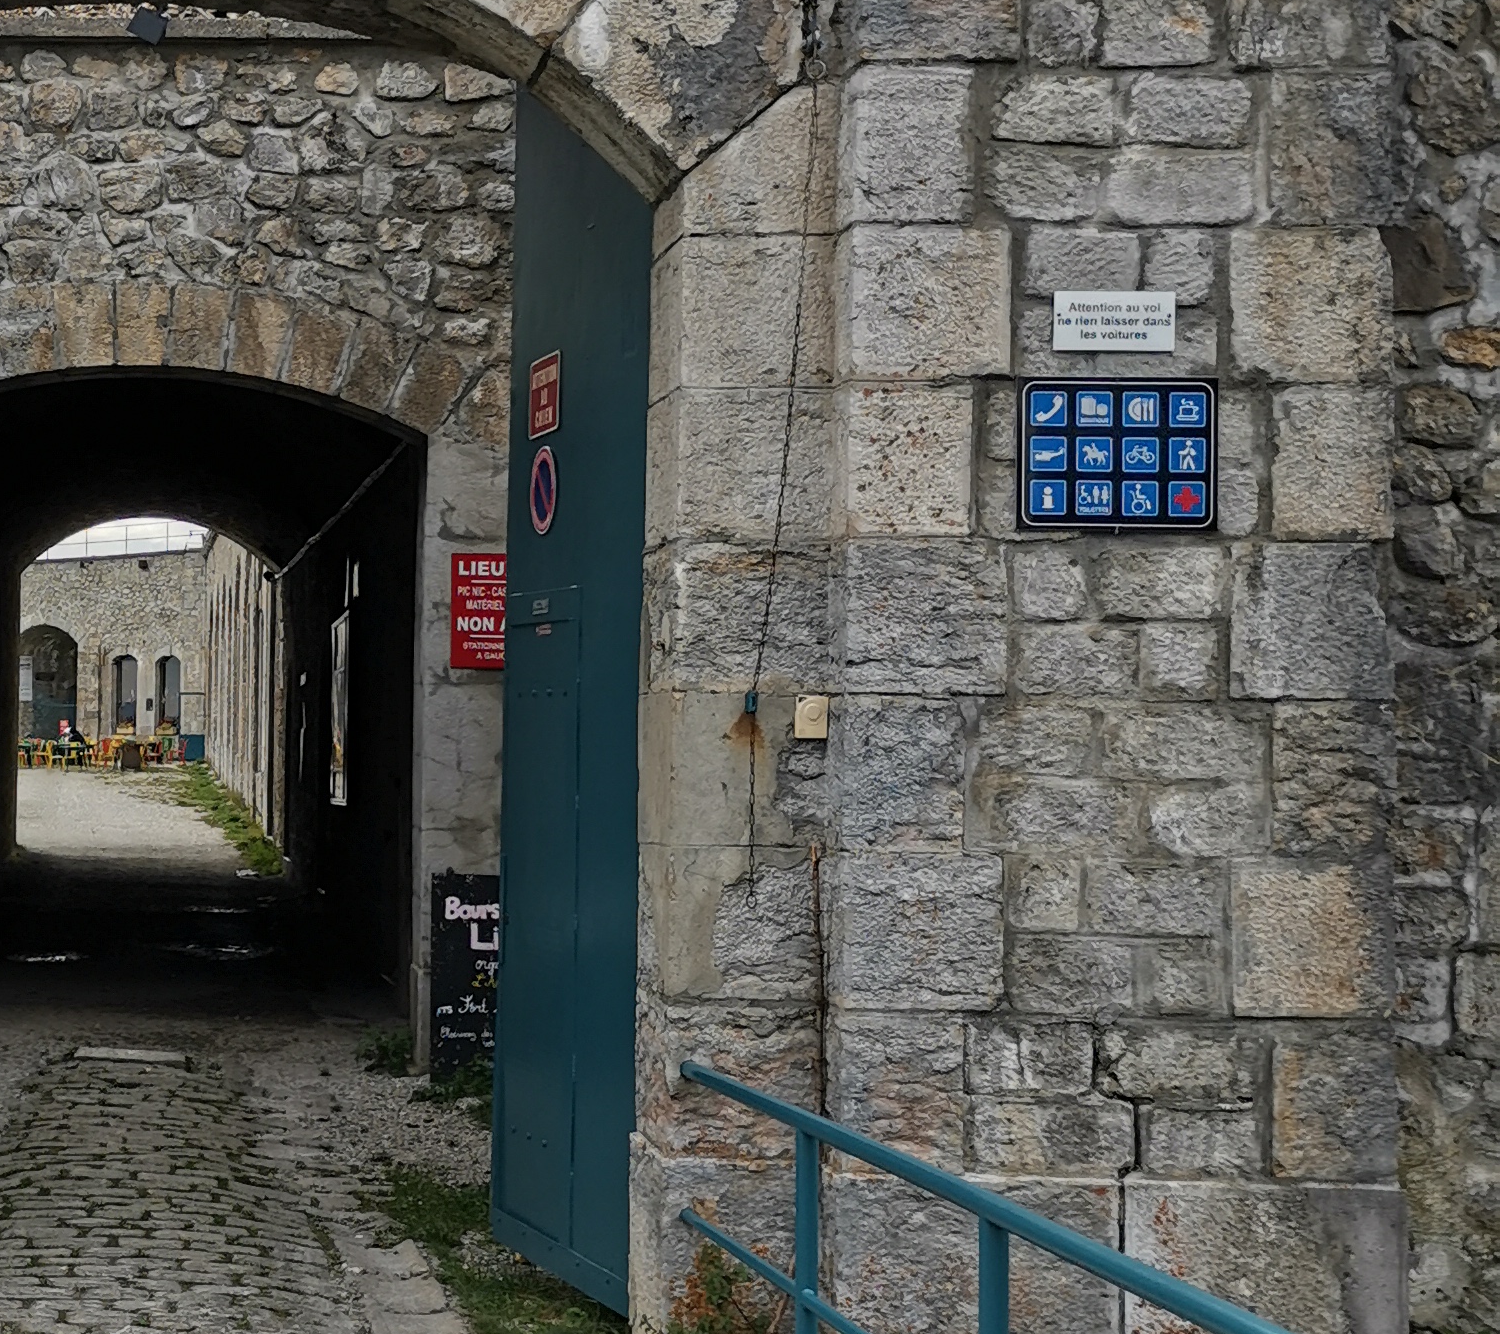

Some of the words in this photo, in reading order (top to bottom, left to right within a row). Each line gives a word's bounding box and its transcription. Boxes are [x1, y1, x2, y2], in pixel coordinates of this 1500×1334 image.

[1068, 302, 1122, 312] Attention
[1126, 304, 1140, 312] au
[1143, 302, 1161, 312] vol
[1058, 317, 1072, 325] ne
[1075, 316, 1097, 325] rien
[1101, 316, 1140, 326] laisser
[1143, 316, 1171, 326] dans
[1080, 329, 1097, 339] les
[1101, 330, 1148, 340] voitures
[456, 616, 495, 632] NON
